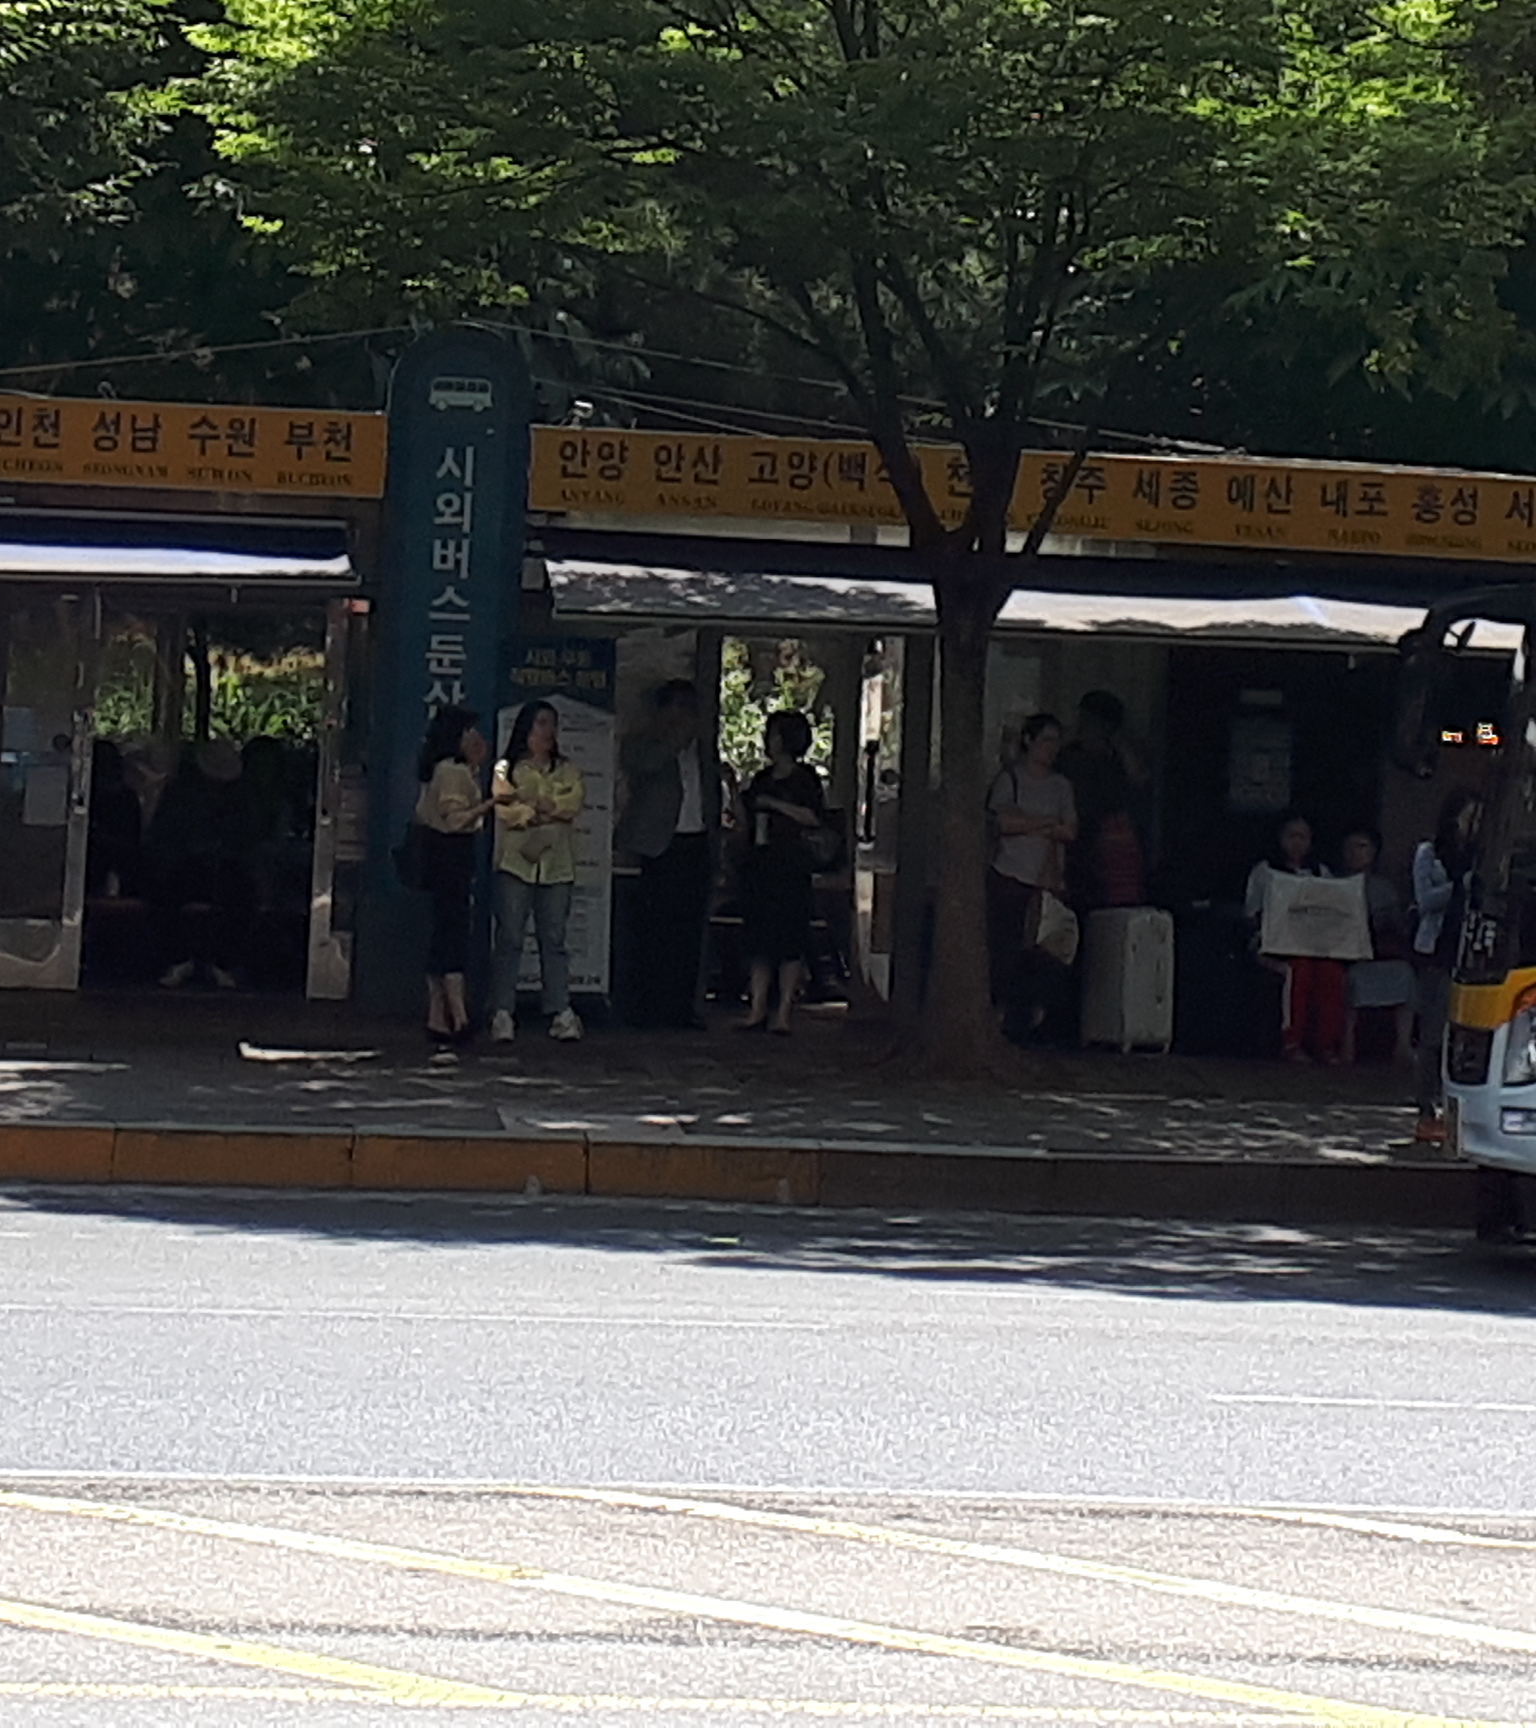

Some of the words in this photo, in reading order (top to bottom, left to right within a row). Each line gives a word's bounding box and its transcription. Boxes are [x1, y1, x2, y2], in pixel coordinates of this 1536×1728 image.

[91, 411, 161, 454] 성남
[188, 415, 257, 458] 수원
[284, 419, 353, 463] 부천
[559, 437, 630, 482] 안양
[654, 442, 722, 486] 안산
[1132, 468, 1200, 511] 세종
[1227, 473, 1293, 515] 예산
[1320, 478, 1390, 518] 내포
[1410, 484, 1479, 527] 홍성
